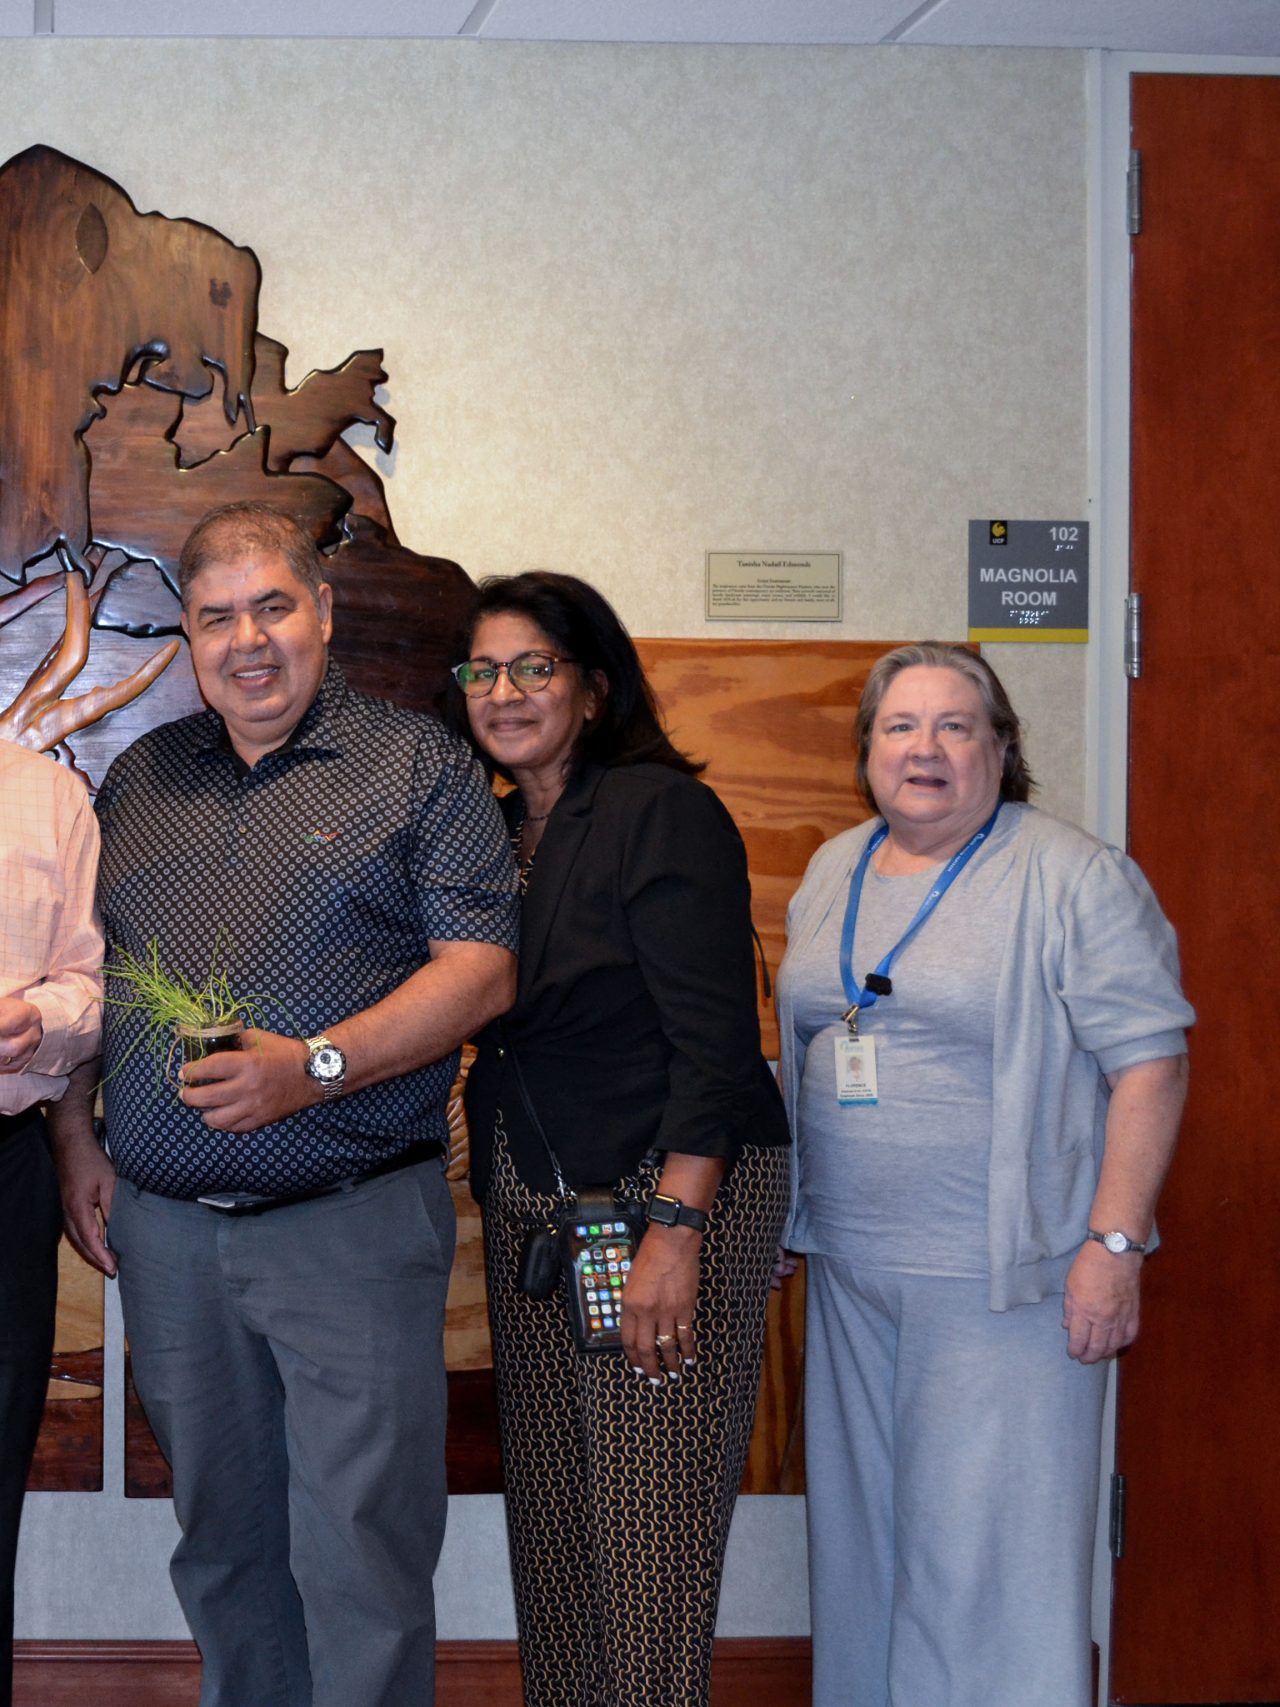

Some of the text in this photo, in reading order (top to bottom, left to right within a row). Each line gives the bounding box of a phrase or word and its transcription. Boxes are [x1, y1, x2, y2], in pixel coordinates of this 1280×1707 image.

[1049, 527, 1079, 541] 102
[980, 568, 1078, 583] MAGNOLIA
[1001, 591, 1057, 606] ROOM
